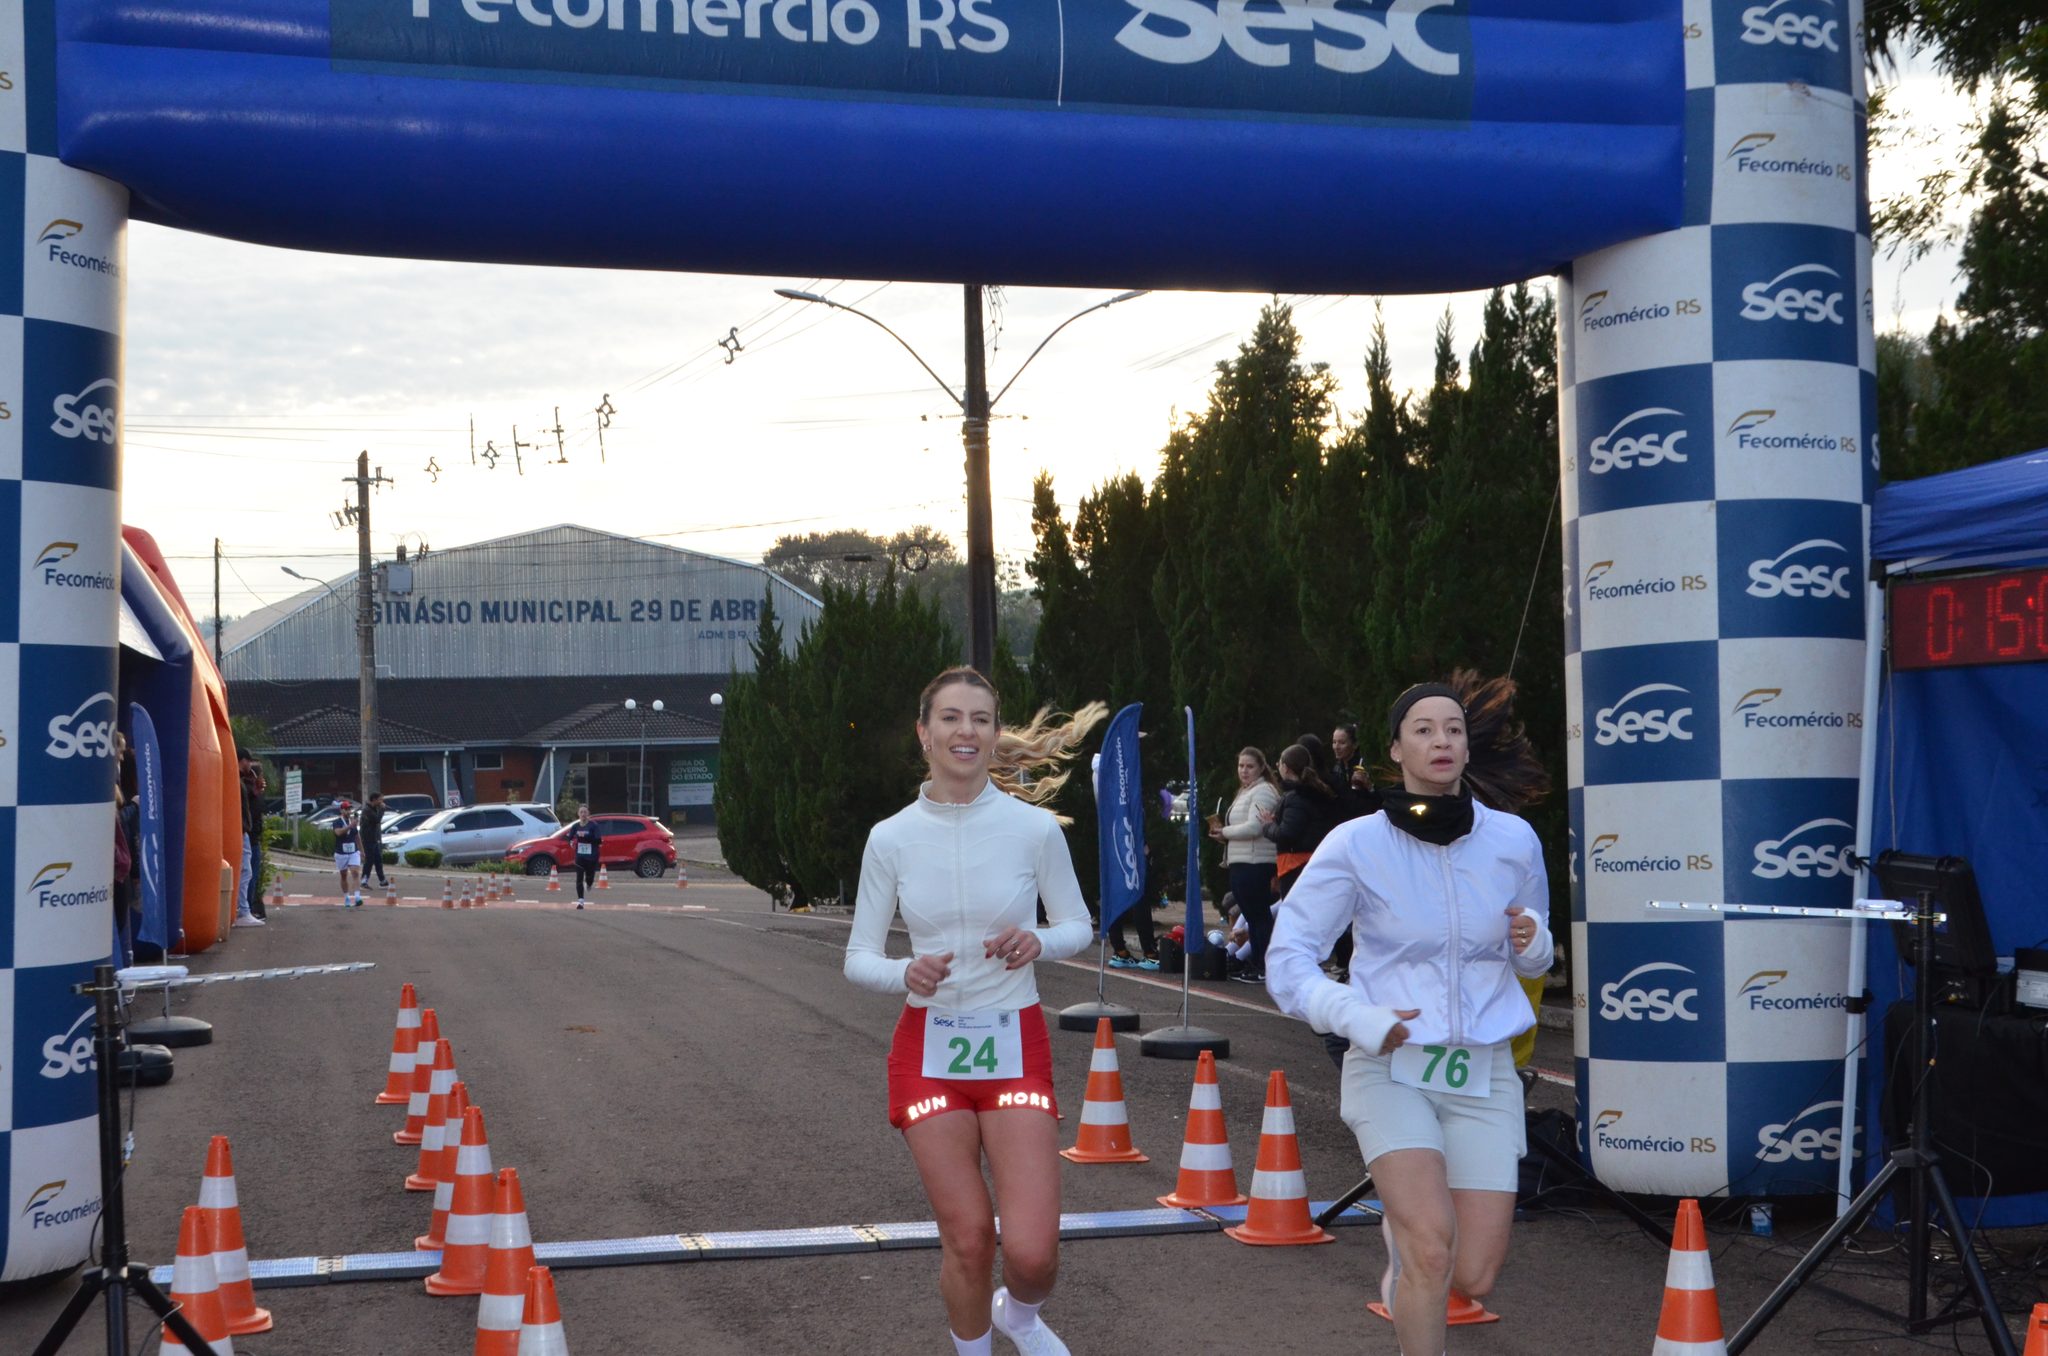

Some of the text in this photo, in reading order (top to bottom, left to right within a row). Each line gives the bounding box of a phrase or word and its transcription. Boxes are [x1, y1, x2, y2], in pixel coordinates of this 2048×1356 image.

[908, 0, 1010, 53] RS
[1740, 6, 1840, 53] Sesc
[1738, 158, 1852, 182] Fecomércio RS
[1584, 299, 1702, 332] Fecomércio RS
[1740, 282, 1844, 325] Sesc
[1589, 430, 1688, 475] Sesc
[1739, 433, 1837, 451] Fecomércio
[1840, 436, 1857, 453] RS
[1589, 577, 1676, 600] Fecomércio
[1681, 575, 1708, 591] RS
[1746, 559, 1851, 599] Sesc
[372, 596, 780, 625] GINÁSIO MUNICIPAL 29 DE ABR
[1594, 708, 1693, 746] Sesc
[1744, 712, 1863, 730] Fecomércio RS
[1595, 857, 1681, 873] Fecomércio
[1687, 855, 1713, 870] RS
[1600, 983, 1699, 1022] Sesc
[933, 1016, 955, 1028] Sesc
[39, 1034, 98, 1080] Se
[948, 1036, 998, 1074] 24
[1422, 1045, 1471, 1089] 76
[908, 1092, 1050, 1121] RUN MORE
[1599, 1133, 1684, 1153] Fecomércio
[1690, 1138, 1717, 1153] RS
[34, 1196, 102, 1229] Fecomérci
